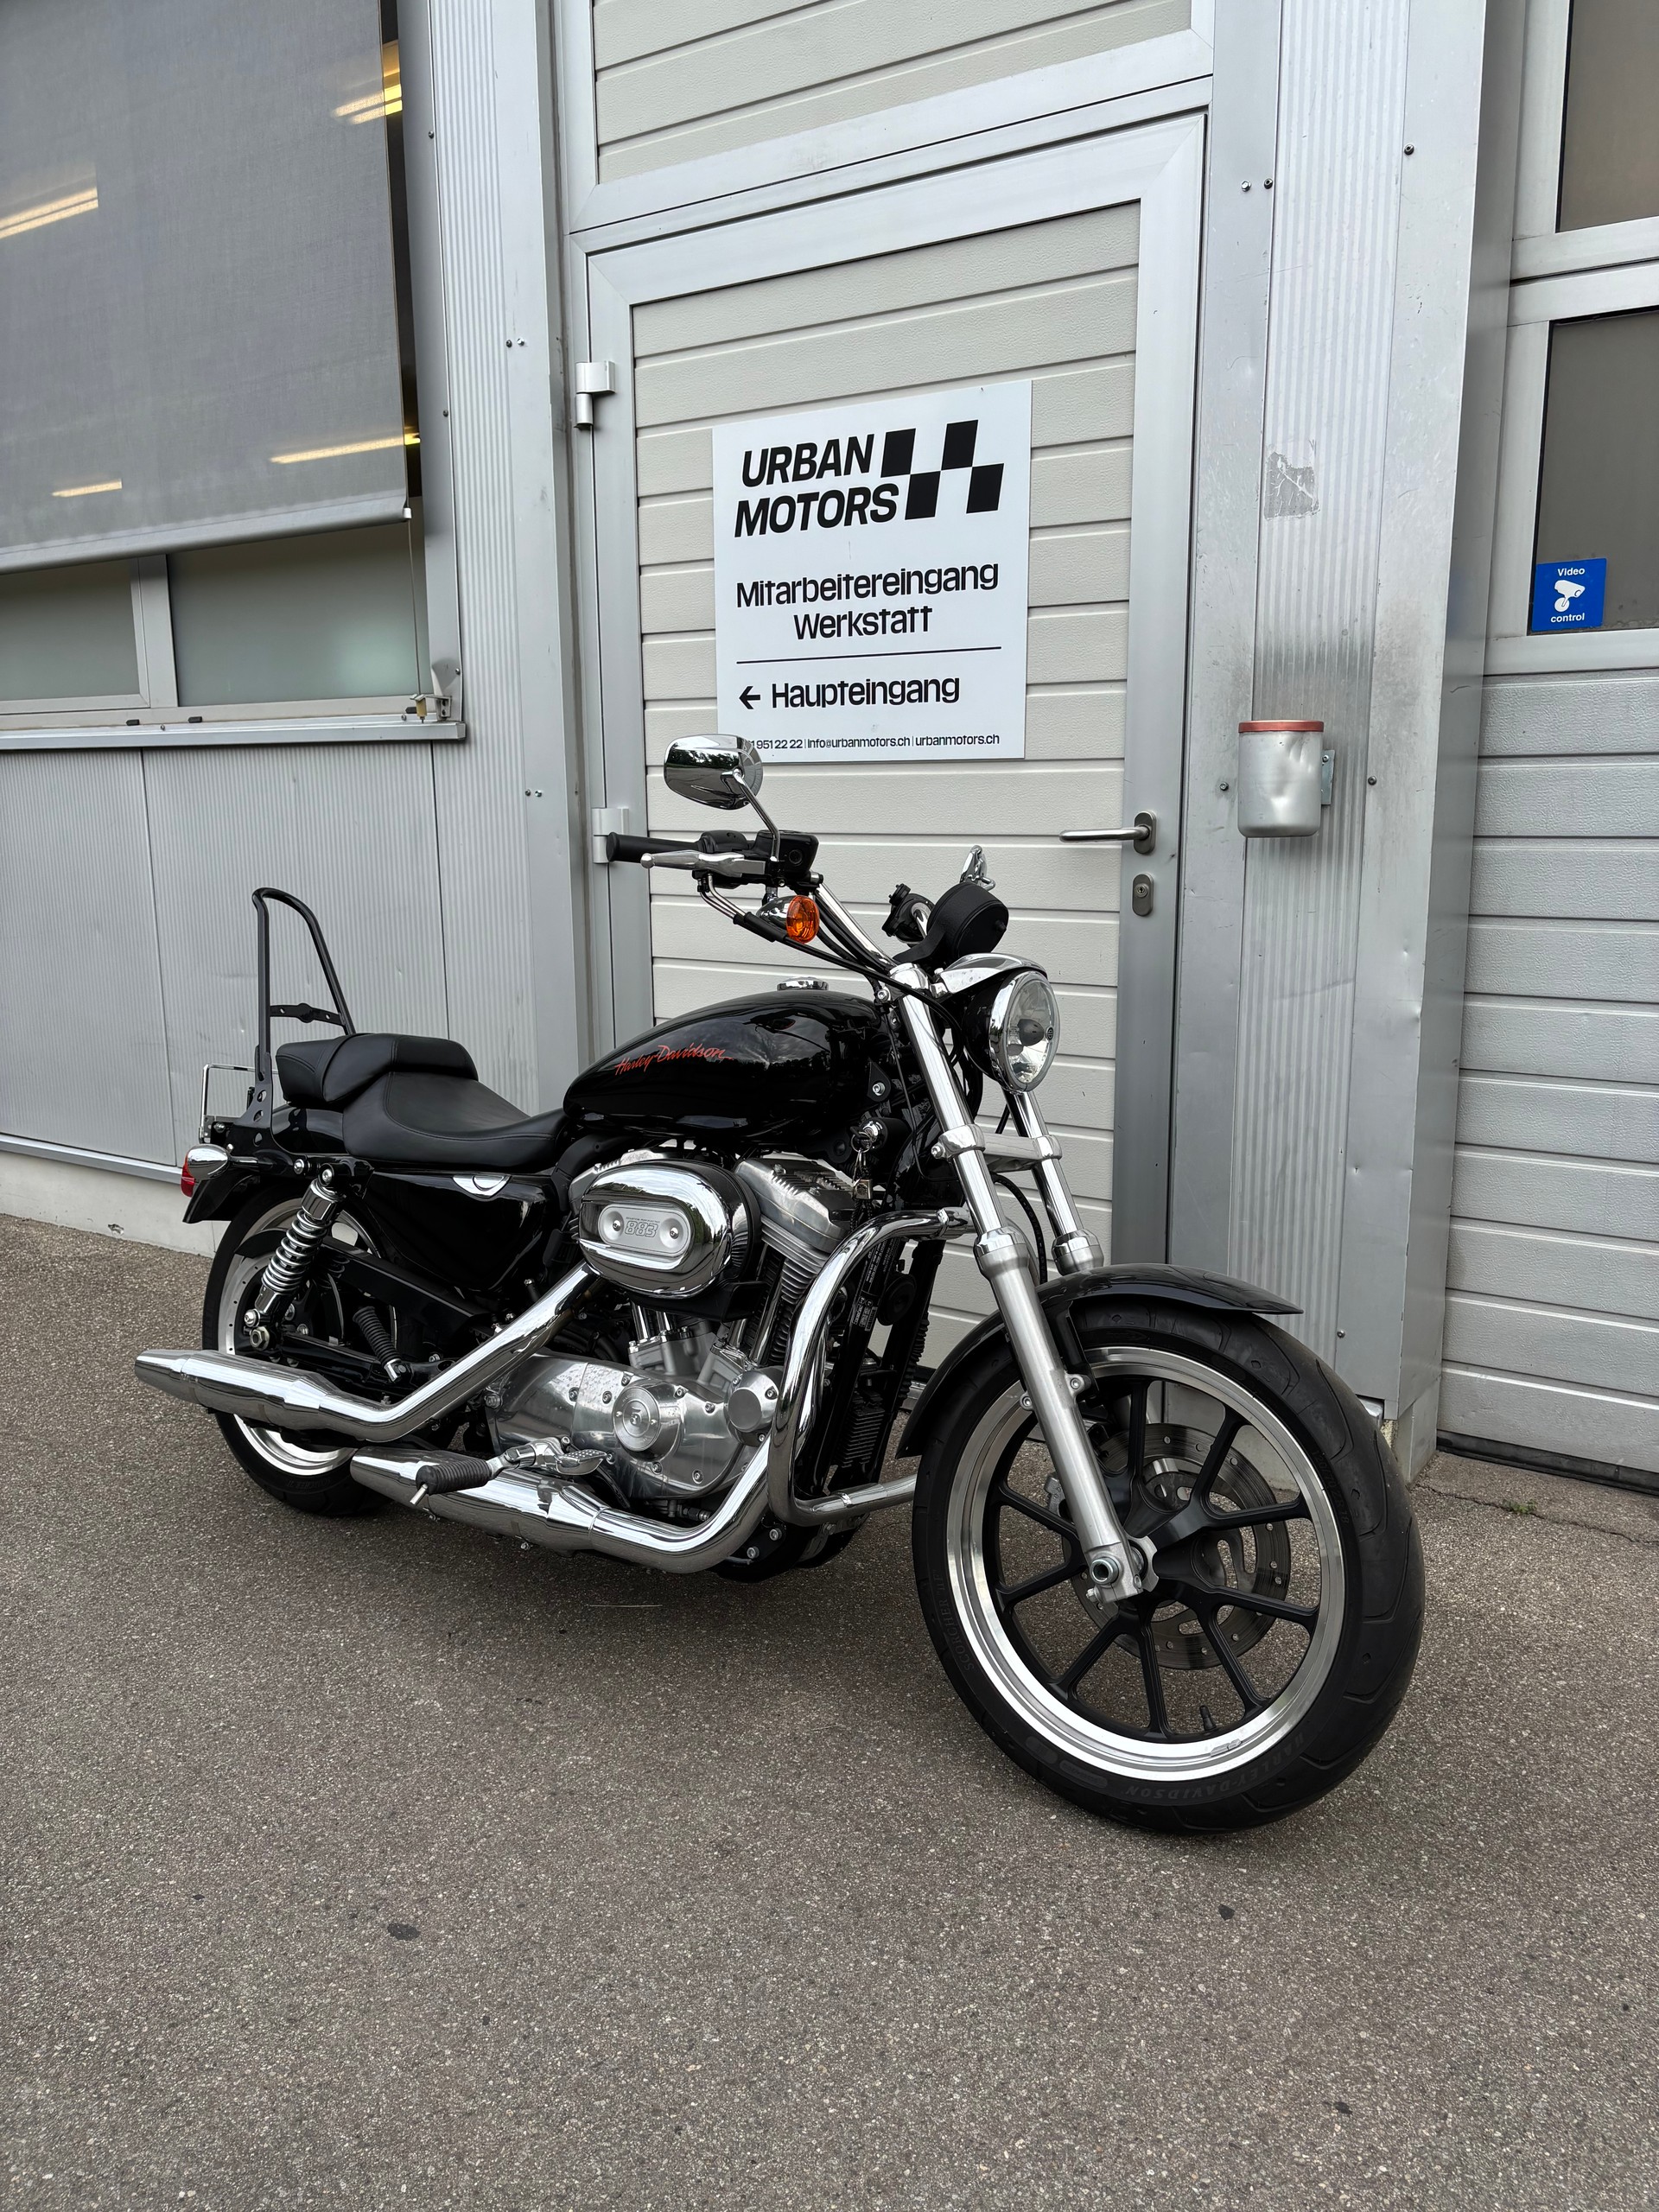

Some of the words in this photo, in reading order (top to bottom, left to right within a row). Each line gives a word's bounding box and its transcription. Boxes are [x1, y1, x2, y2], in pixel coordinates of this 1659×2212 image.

[741, 434, 874, 487] URBAN
[734, 483, 899, 537] MOTORS
[737, 563, 998, 607] Mitarbeitereingang
[1558, 568, 1585, 576] Video
[794, 606, 933, 640] Werkstatt
[1551, 613, 1586, 623] control
[772, 677, 960, 709] Haupteingang
[757, 740, 773, 750] 951
[775, 740, 788, 749] 22
[790, 740, 804, 749] 22
[808, 736, 910, 749] info@urbanmotors.ch
[916, 734, 1000, 747] urbanmotors.ch
[614, 1043, 734, 1076] Harley-Davidson
[625, 1220, 659, 1238] 883
[939, 1599, 975, 1671] SCORCHER
[1126, 1732, 1305, 1801] HARLEY-DAVIDSON
